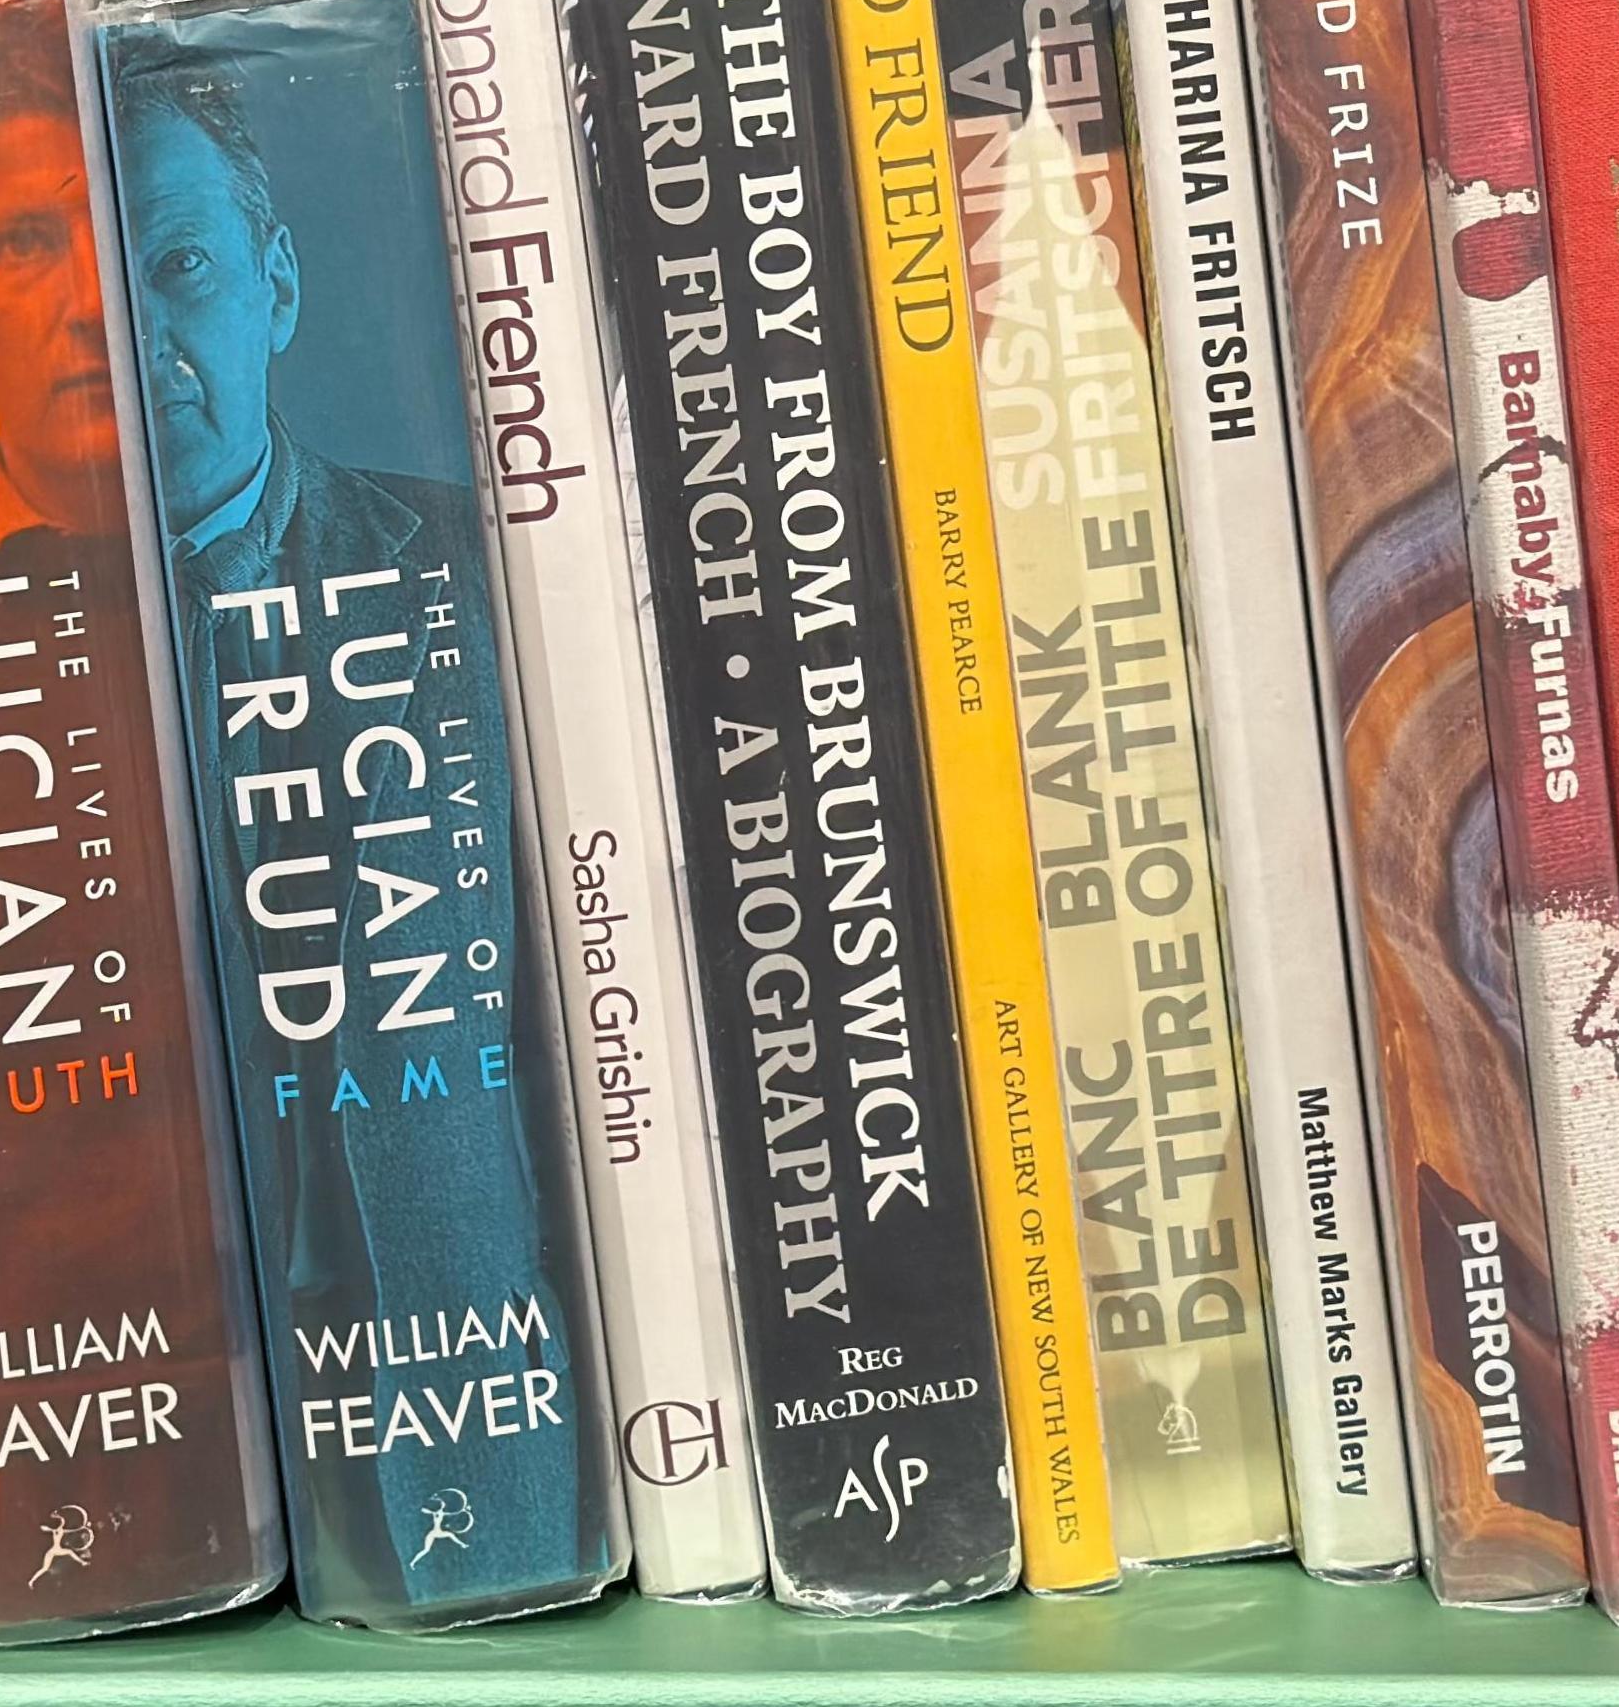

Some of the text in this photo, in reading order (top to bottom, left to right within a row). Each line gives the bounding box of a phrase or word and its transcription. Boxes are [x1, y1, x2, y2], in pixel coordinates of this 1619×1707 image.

[739, 164, 823, 348] BOY
[865, 36, 956, 354] FRIEND
[948, 37, 1066, 511] SUSANNA
[1324, 64, 1383, 250] FRIZE
[468, 230, 586, 527] French
[657, 247, 765, 627] FRENCH
[1188, 220, 1257, 442] FRITSCH
[766, 368, 858, 644] FROM
[934, 487, 983, 716] BARRY PEARCE
[1498, 349, 1577, 803] Barnaby Furnas
[49, 570, 132, 1024] THE LIVES OF
[211, 585, 347, 1042] FREUD
[321, 567, 458, 1032] LUCIAN
[420, 563, 504, 1012] THE LIVES OF
[712, 715, 781, 776] A
[1011, 604, 1117, 930] BLANK
[1082, 509, 1194, 917] OF TITLE
[273, 1043, 511, 1117] FAME
[568, 828, 651, 1165] Sasha Grishin
[720, 787, 854, 1327] BIOGRAPHY
[798, 656, 929, 1224] BRUNSWICK
[993, 998, 1081, 1546] ART GALLERY OF NEW SOUTH WALES
[1065, 1039, 1167, 1356] BLANC
[1134, 932, 1249, 1343] DE TITRE
[1298, 1087, 1368, 1497] Matthew Marks Gallery
[294, 1293, 551, 1376] WILLIAM
[300, 1368, 564, 1461] FEAVER
[1457, 1221, 1527, 1474] PERROTIN
